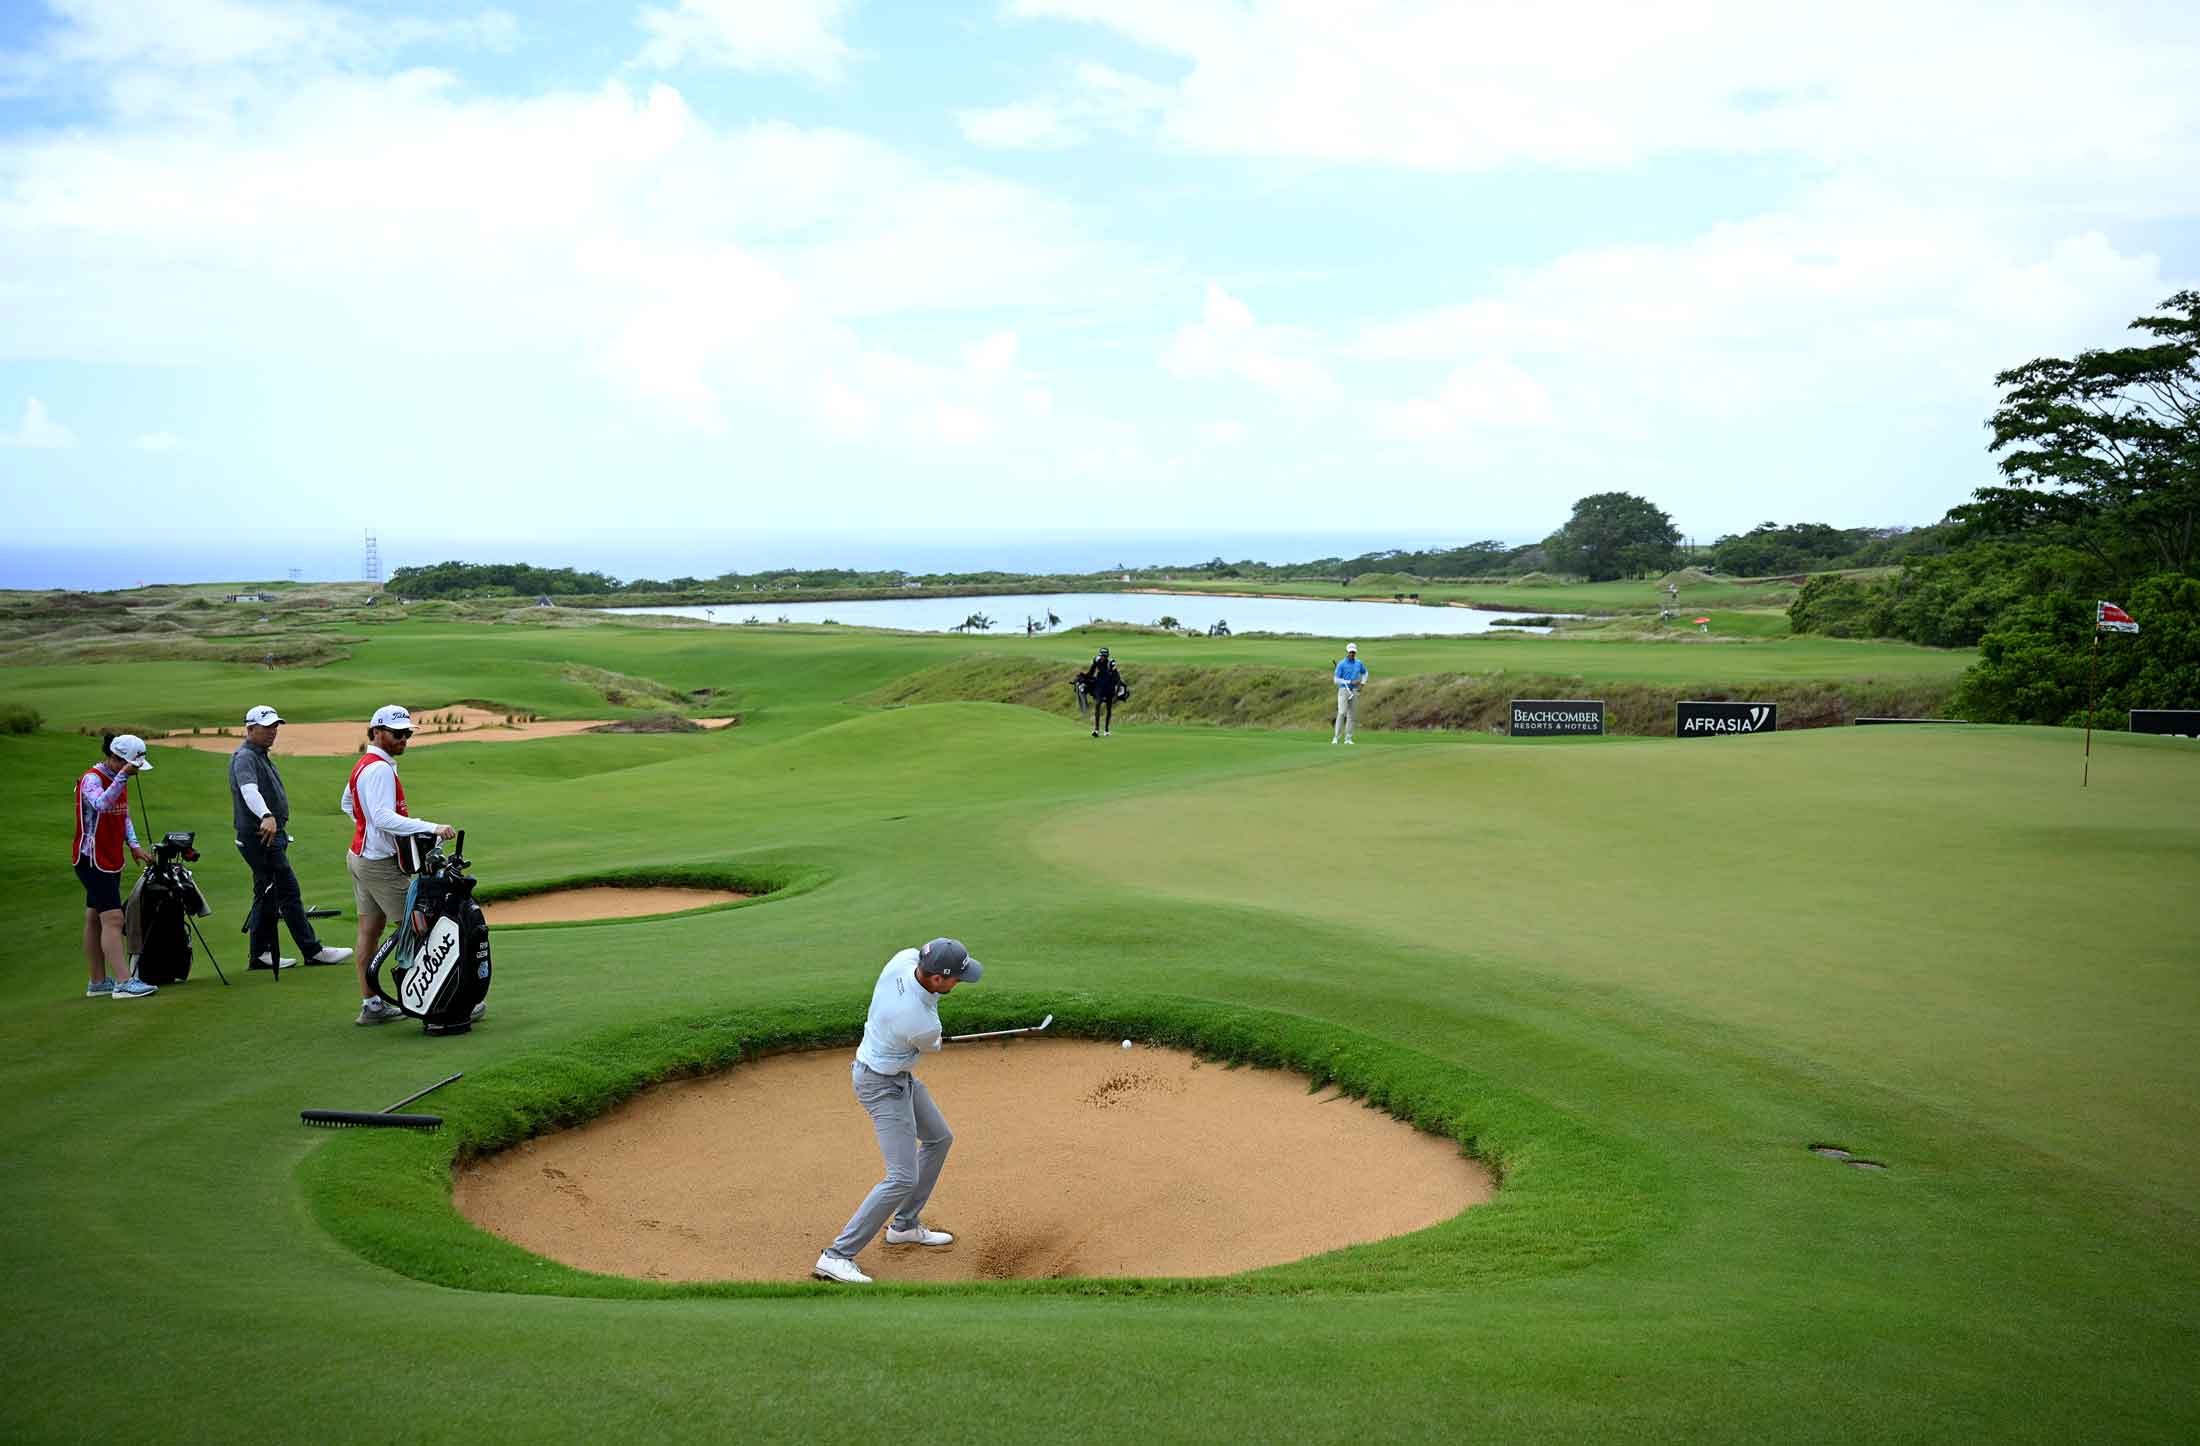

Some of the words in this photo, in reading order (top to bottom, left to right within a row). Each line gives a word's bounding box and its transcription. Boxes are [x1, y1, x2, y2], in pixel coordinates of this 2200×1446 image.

[1514, 709, 1600, 722] BEACHCOMBER
[1683, 717, 1752, 732] AFRASIA
[406, 932, 455, 1008] Titleist
